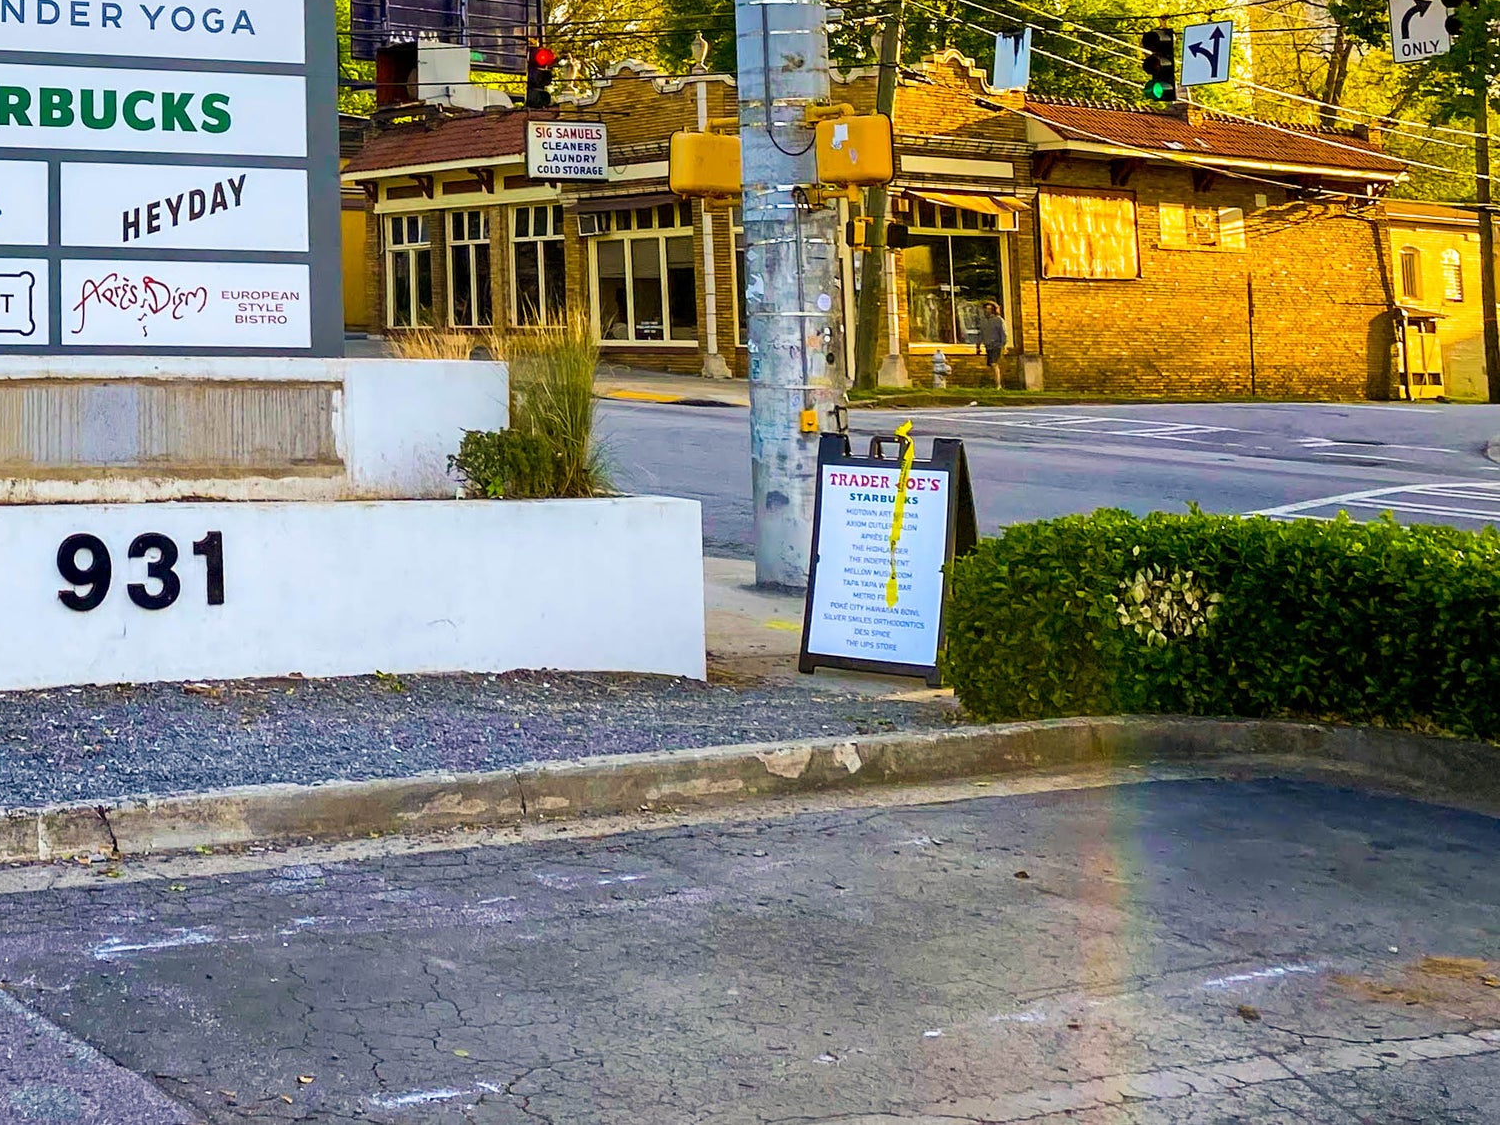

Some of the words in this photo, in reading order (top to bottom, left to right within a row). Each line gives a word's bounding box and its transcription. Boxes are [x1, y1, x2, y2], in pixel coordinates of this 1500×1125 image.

[139, 3, 256, 36] YOGA
[1401, 40, 1440, 57] ONLY
[535, 127, 552, 138] SIG
[556, 127, 602, 140] SAMUELS
[542, 141, 597, 151] CLEANERS
[545, 153, 596, 163] LAUNDRY
[537, 165, 560, 174] COLD
[562, 166, 603, 176] STORAGE
[122, 173, 247, 243] HEYDAY
[221, 290, 300, 301] EUROPEAN
[238, 303, 284, 313] STYLE
[234, 314, 288, 325] BISTRO
[830, 473, 889, 488] TRADER
[850, 493, 918, 505] STARBUKS
[866, 545, 909, 554] HIGHLADER
[863, 556, 910, 566] INDEPENENT
[56, 531, 225, 612] 931
